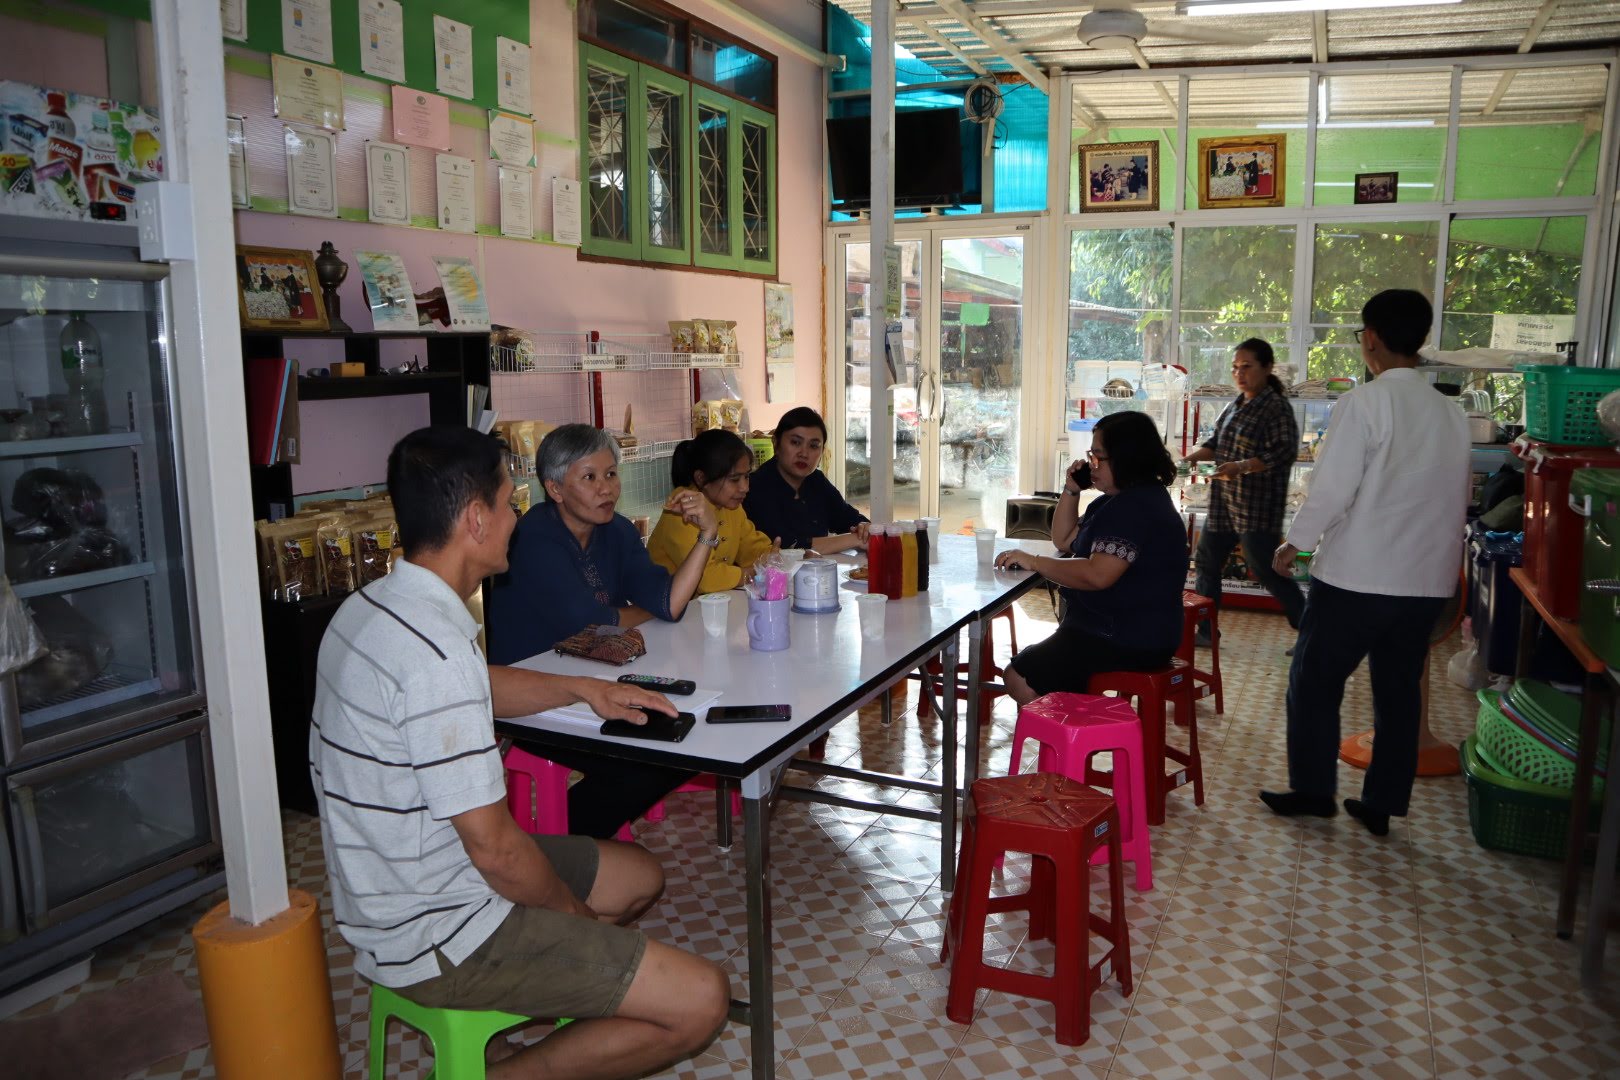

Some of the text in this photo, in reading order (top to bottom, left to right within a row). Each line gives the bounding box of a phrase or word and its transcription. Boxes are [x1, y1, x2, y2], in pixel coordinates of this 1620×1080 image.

[49, 142, 80, 160] Malee
[1, 156, 16, 167] 20
[1517, 322, 1554, 330] PREMIUM
